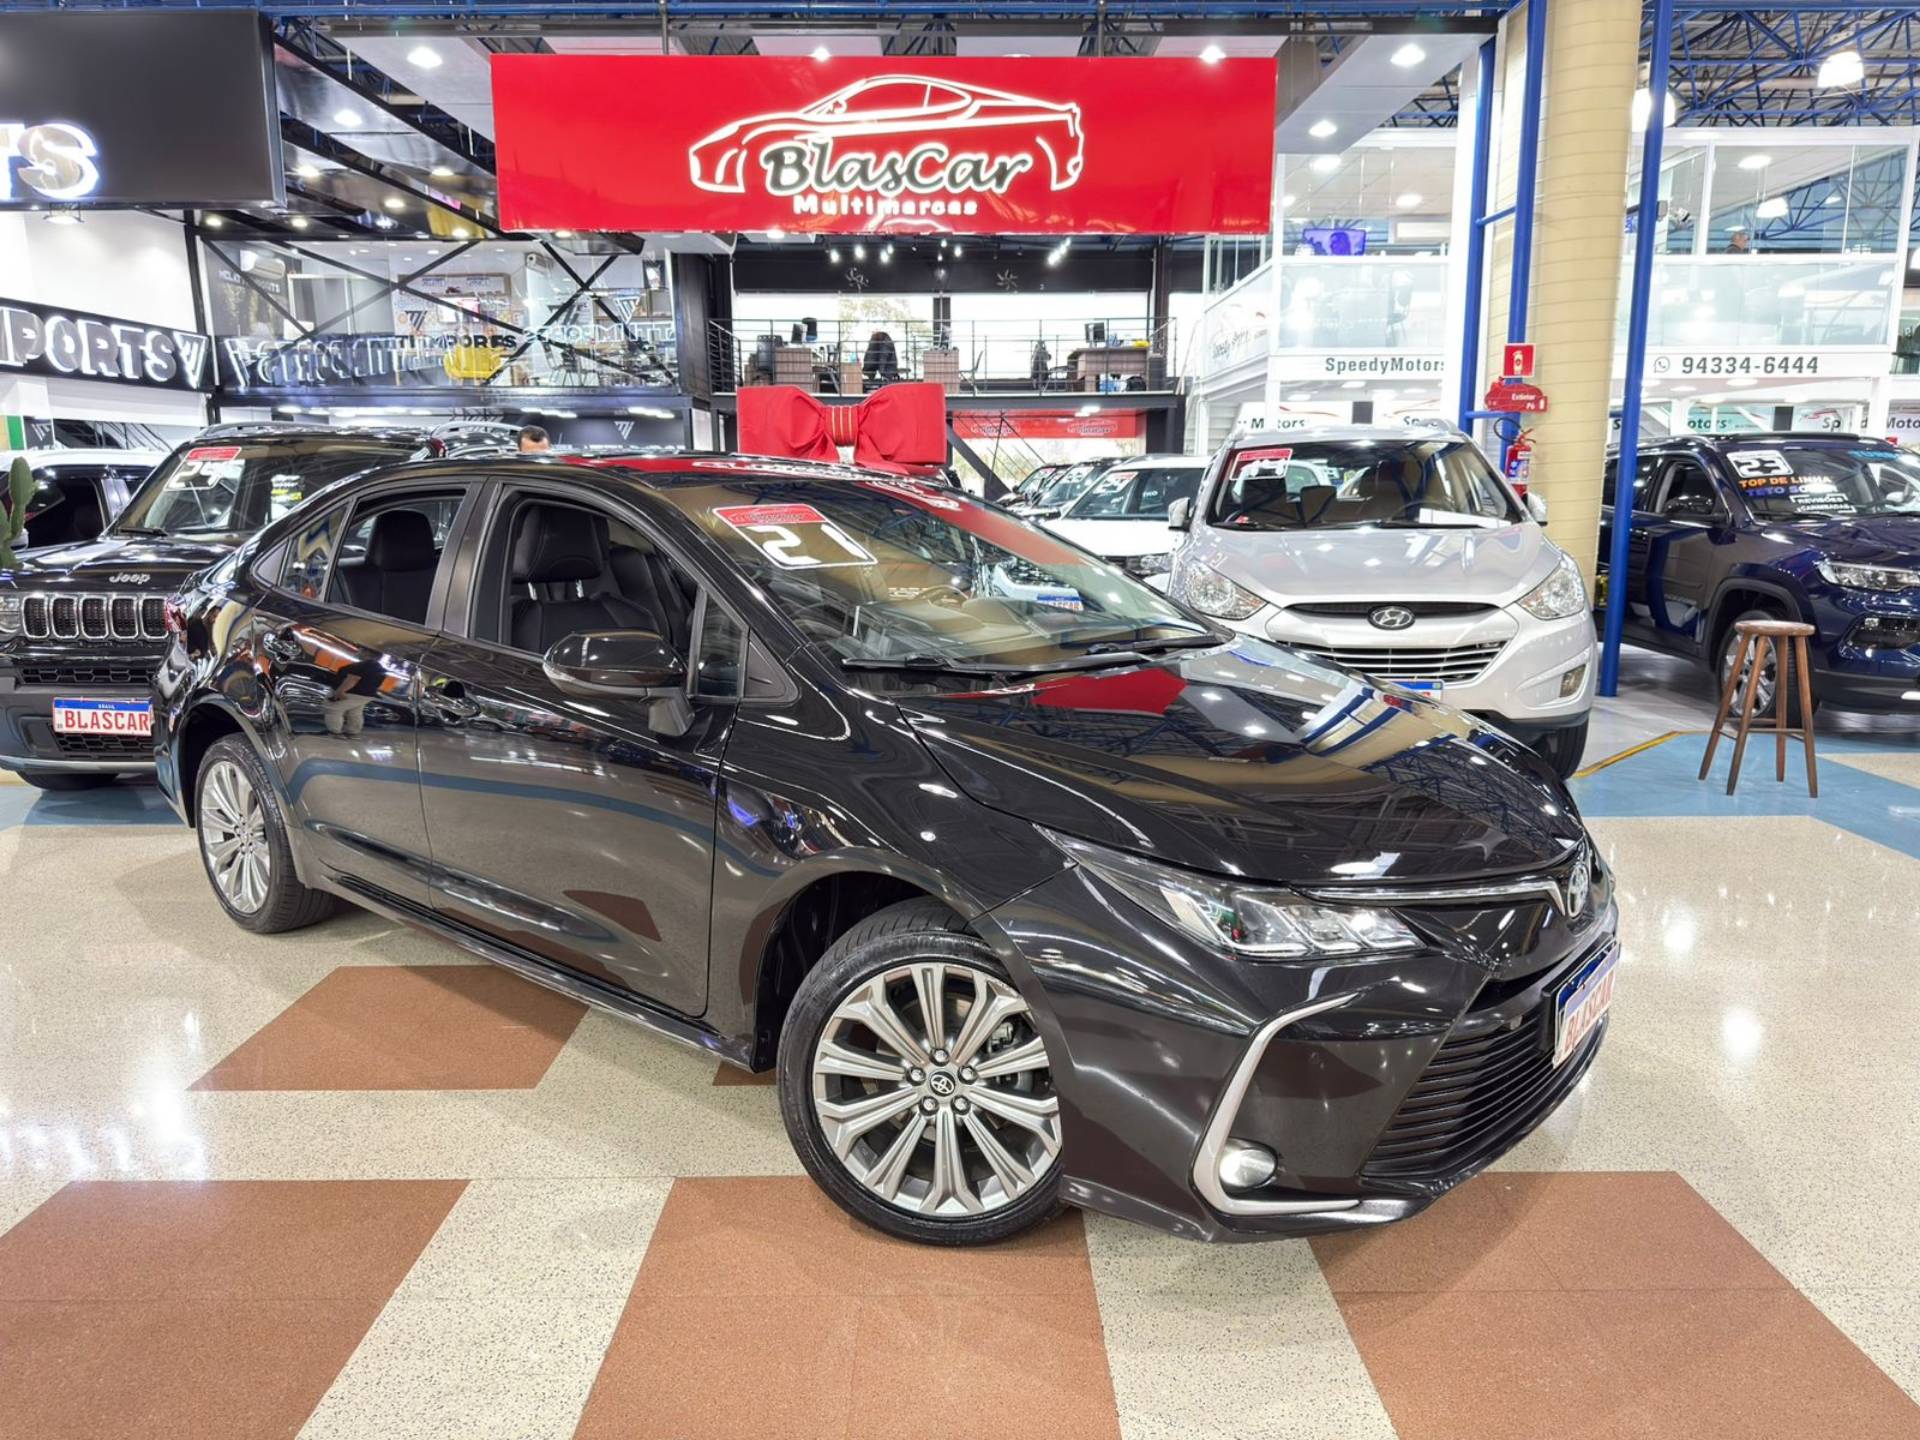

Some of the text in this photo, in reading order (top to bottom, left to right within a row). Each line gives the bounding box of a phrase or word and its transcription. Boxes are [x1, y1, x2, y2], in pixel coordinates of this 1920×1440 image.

[760, 134, 1034, 195] BlasCar
[1681, 356, 1819, 374] 94334-6444
[1738, 478, 1767, 489] TOP
[1769, 477, 1789, 486] DE
[1746, 486, 1785, 497] TETO
[745, 523, 869, 566] 21
[109, 572, 151, 585] Jeep
[64, 710, 150, 732] BLASCAR
